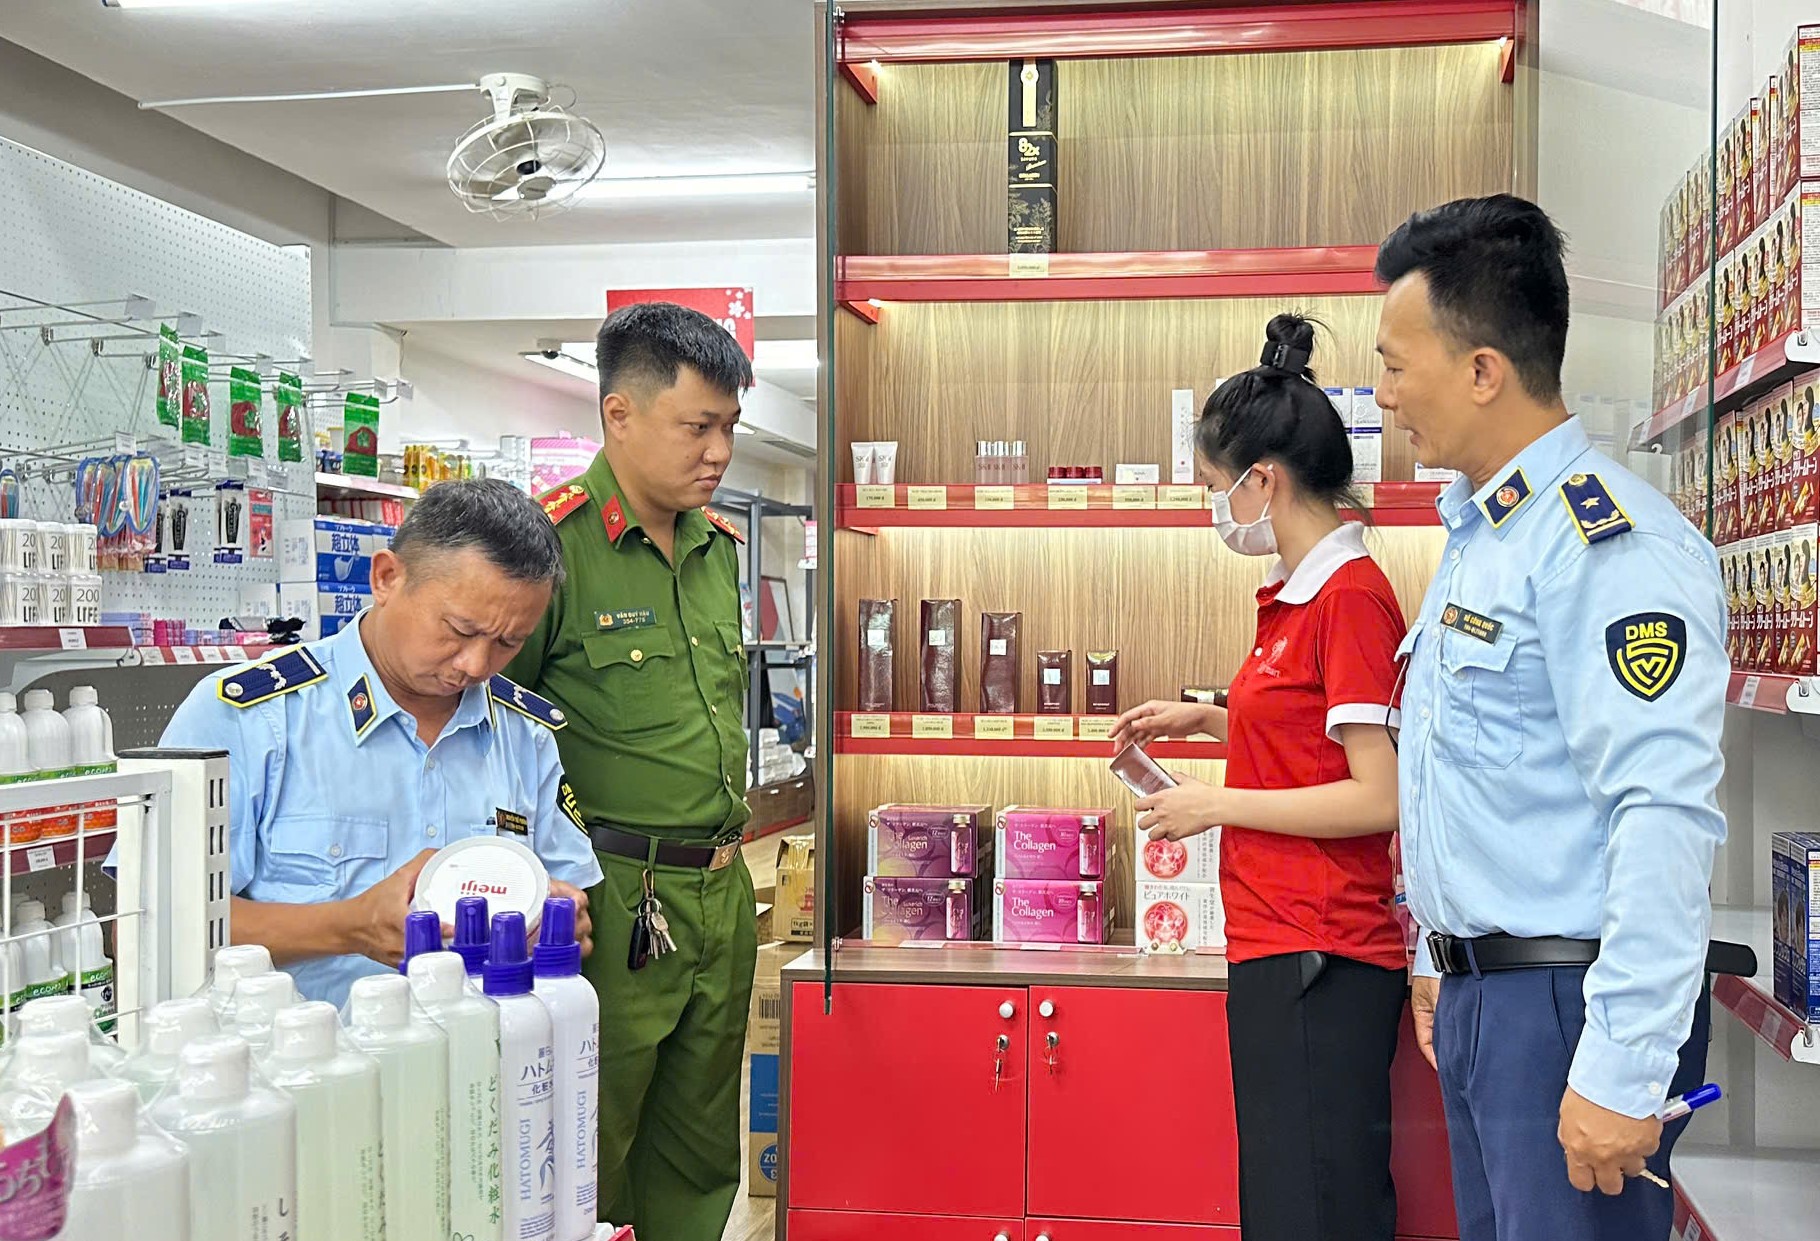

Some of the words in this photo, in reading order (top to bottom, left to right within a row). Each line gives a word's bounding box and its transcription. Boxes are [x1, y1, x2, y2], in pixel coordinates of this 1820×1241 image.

[76, 588, 100, 603] 200
[77, 606, 98, 623] LIFE
[1625, 621, 1668, 640] DMS
[1014, 830, 1032, 841] The
[1013, 840, 1056, 853] Collagen
[460, 880, 508, 895] meiji
[1012, 896, 1030, 907] The
[1143, 891, 1190, 901] ピュアホワイト
[1011, 905, 1054, 919] Collagen
[576, 1089, 588, 1169] HATOMUGI
[518, 1118, 532, 1201] HATOMUGI
